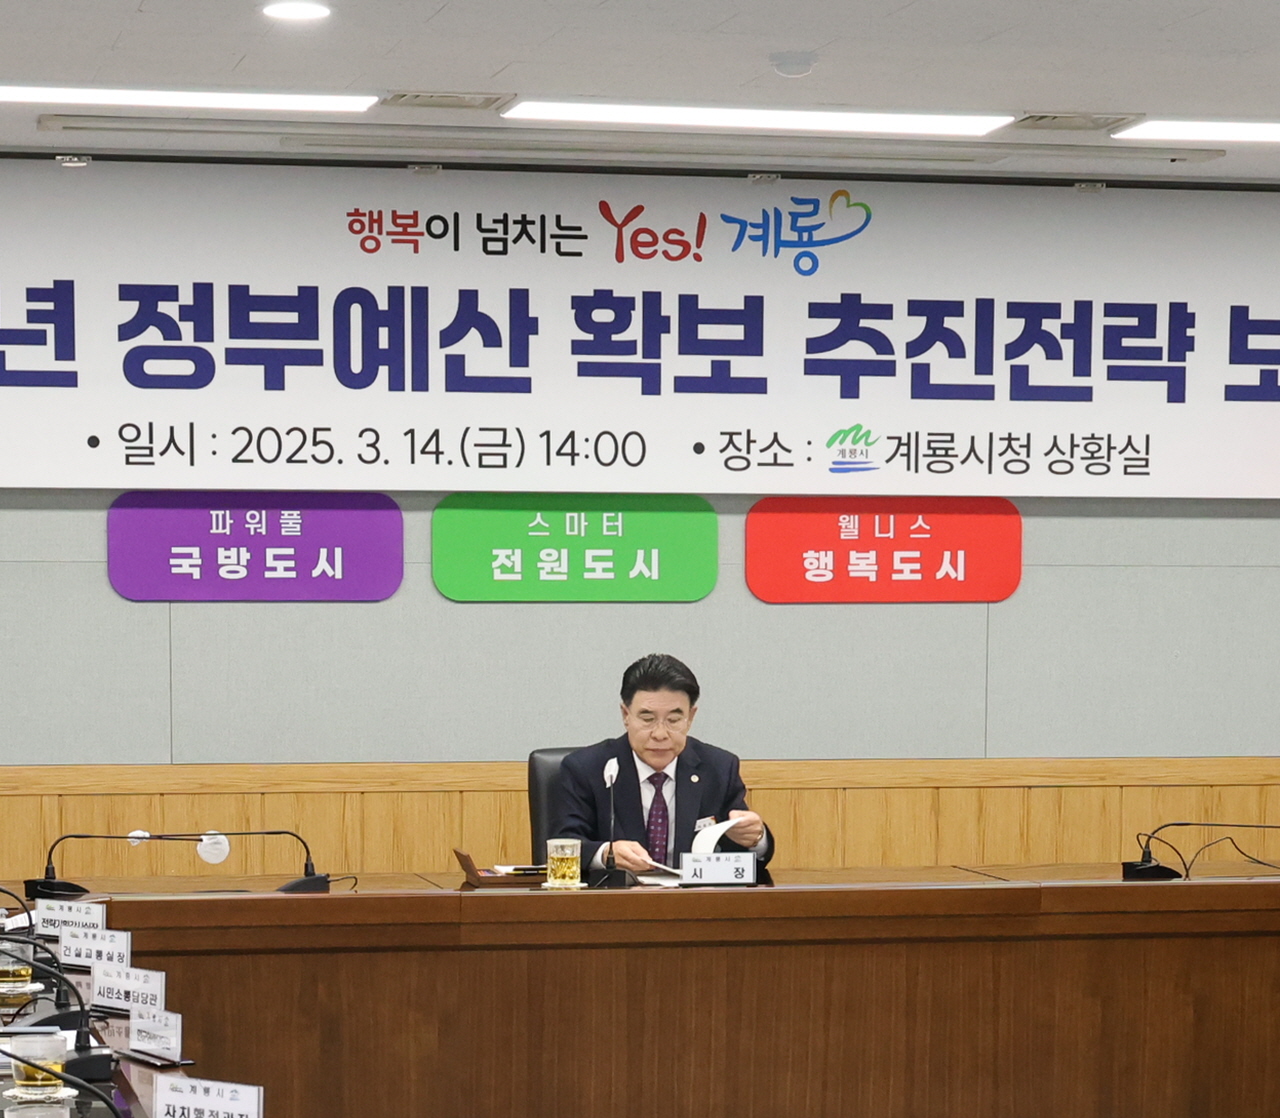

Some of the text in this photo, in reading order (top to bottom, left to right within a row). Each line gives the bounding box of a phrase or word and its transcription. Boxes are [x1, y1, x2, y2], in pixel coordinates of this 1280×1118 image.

[346, 194, 834, 277] 행복이 넘치는 Yes! 계룡
[117, 281, 539, 394] 정부예산
[570, 288, 768, 396] 확보
[803, 292, 1196, 404] 추진전략
[230, 425, 344, 465] 2025.
[357, 427, 390, 466] 3.
[403, 426, 526, 469] 14.(금)
[538, 429, 647, 468] 14:00
[884, 430, 1032, 475] 계룡시청
[1043, 432, 1151, 476] 상황실
[209, 510, 303, 538] 파워풀
[527, 511, 625, 538] 스마터
[837, 514, 932, 540] 웰니스
[169, 546, 343, 580] 국방도시
[491, 548, 659, 581] 전원도시
[802, 549, 966, 583] 행복도시
